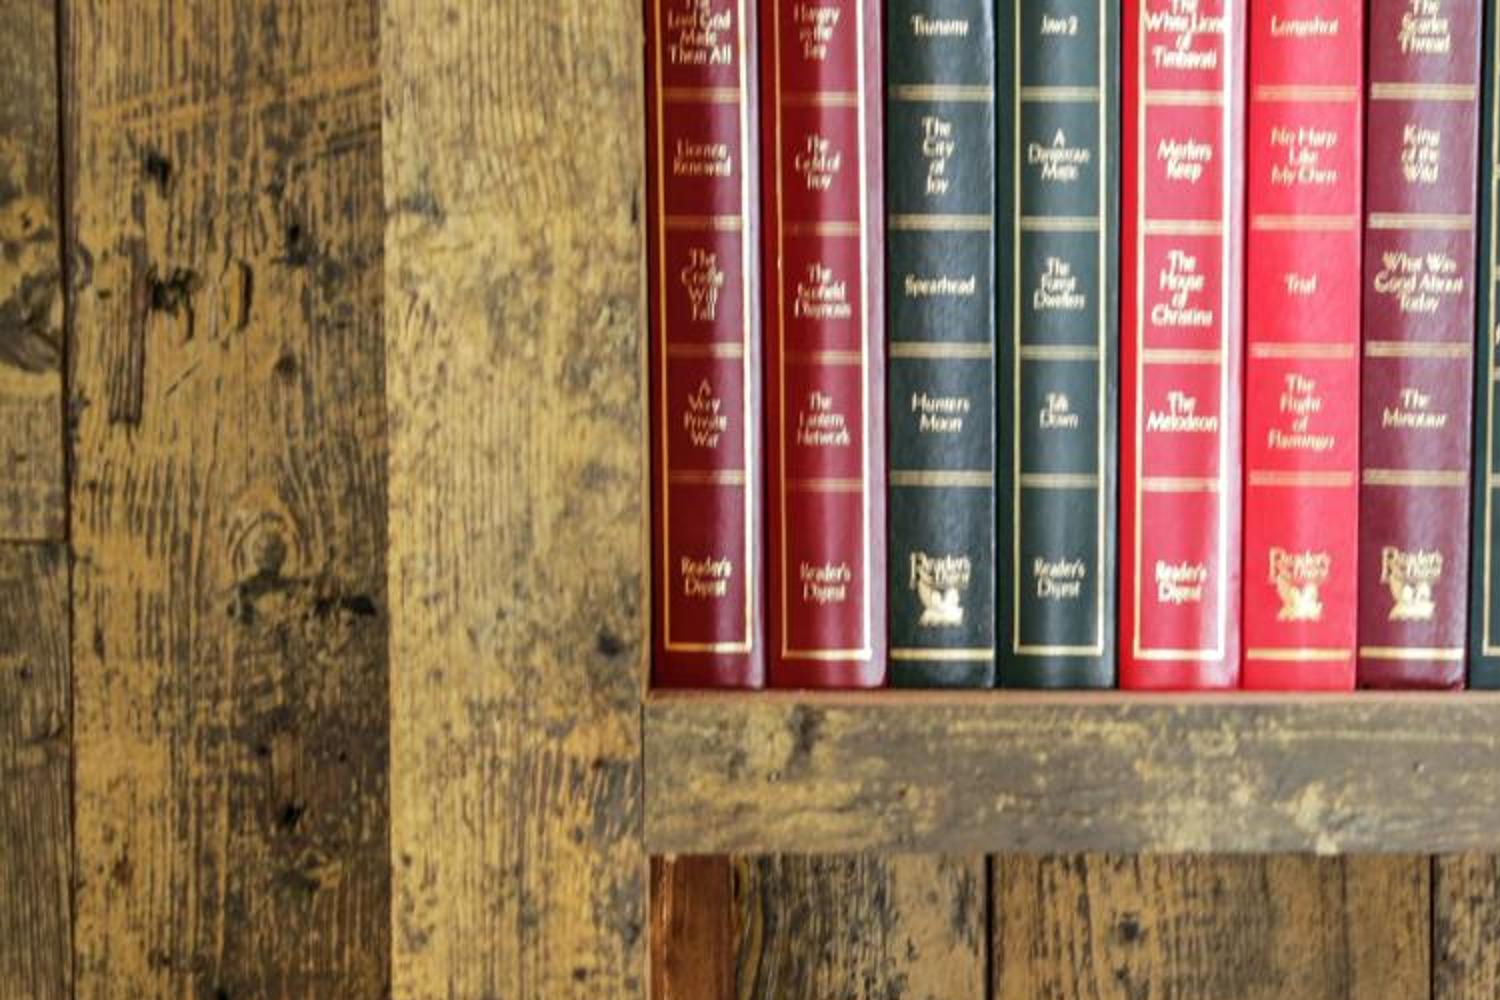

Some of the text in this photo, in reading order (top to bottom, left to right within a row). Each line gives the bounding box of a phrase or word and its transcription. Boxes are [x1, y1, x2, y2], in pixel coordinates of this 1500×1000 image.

[709, 45, 732, 64] All
[922, 116, 951, 138] The
[1053, 128, 1065, 147] A
[690, 248, 716, 267] The
[1048, 257, 1070, 275] The
[1168, 250, 1196, 272] The
[809, 264, 832, 283] The
[905, 273, 975, 299] Spearhead
[1172, 290, 1187, 307] of
[1286, 374, 1315, 394] The
[810, 391, 832, 411] The
[1168, 391, 1196, 411] The
[1401, 389, 1430, 409] The
[1293, 415, 1308, 432] of
